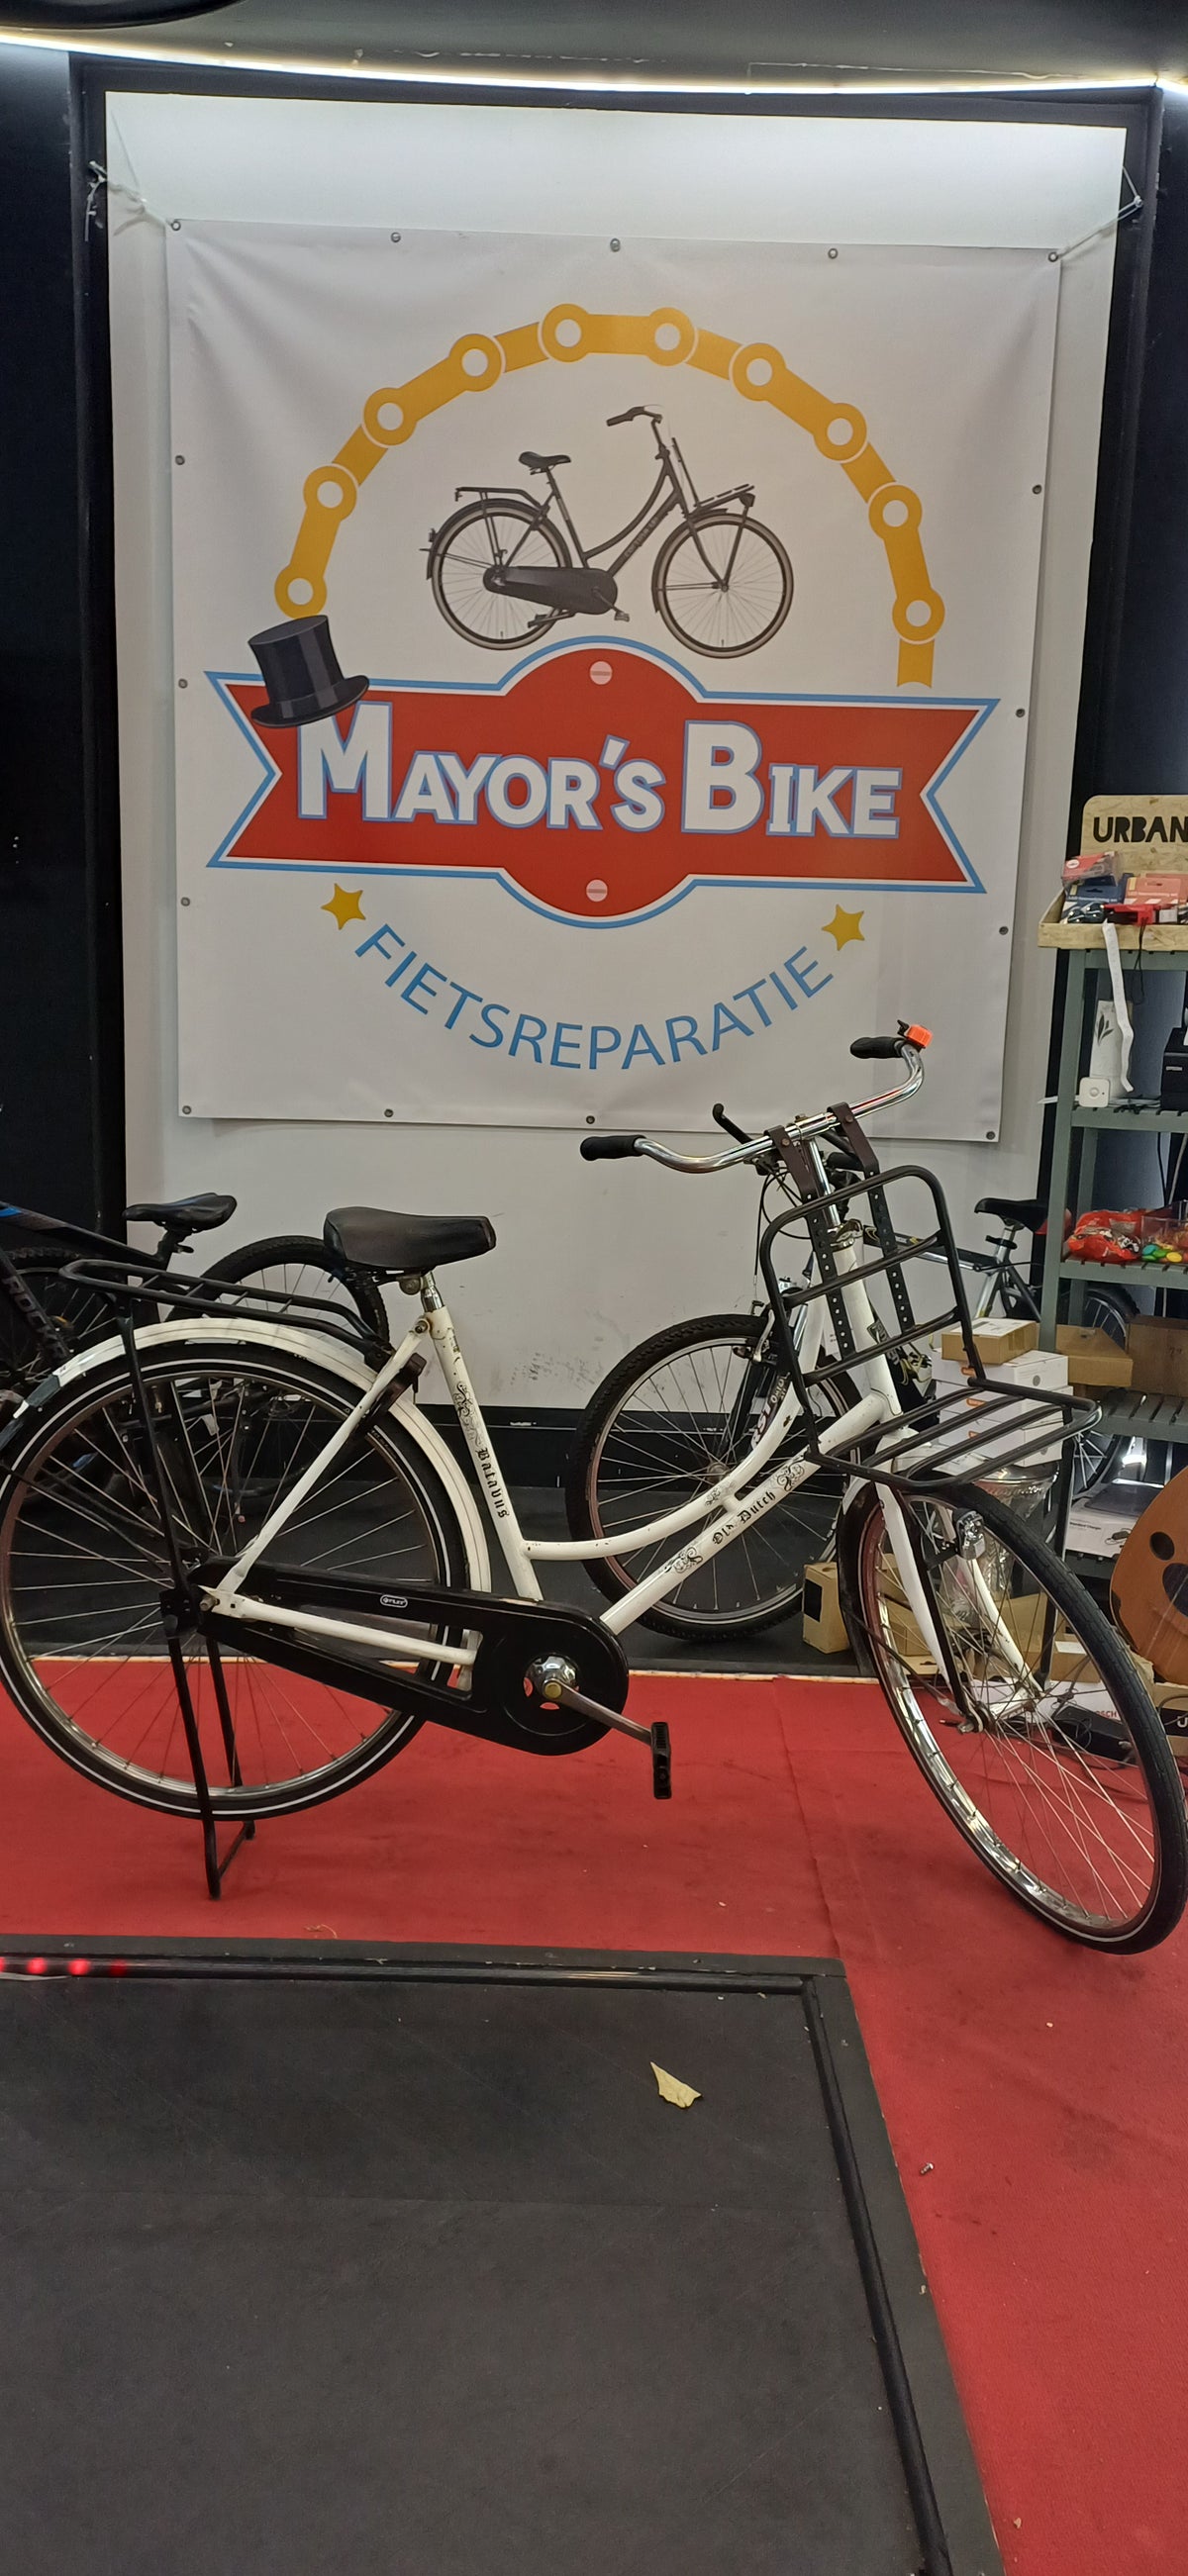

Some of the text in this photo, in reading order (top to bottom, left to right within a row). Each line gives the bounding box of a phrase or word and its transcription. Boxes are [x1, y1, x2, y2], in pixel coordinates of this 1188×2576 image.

[297, 701, 903, 839] MAYOR'S BIKE
[1093, 816, 1188, 843] URBAN
[354, 923, 834, 1070] FIETSREPARATIE
[475, 1447, 510, 1518] Batavus
[737, 1490, 776, 1524] Dutch
